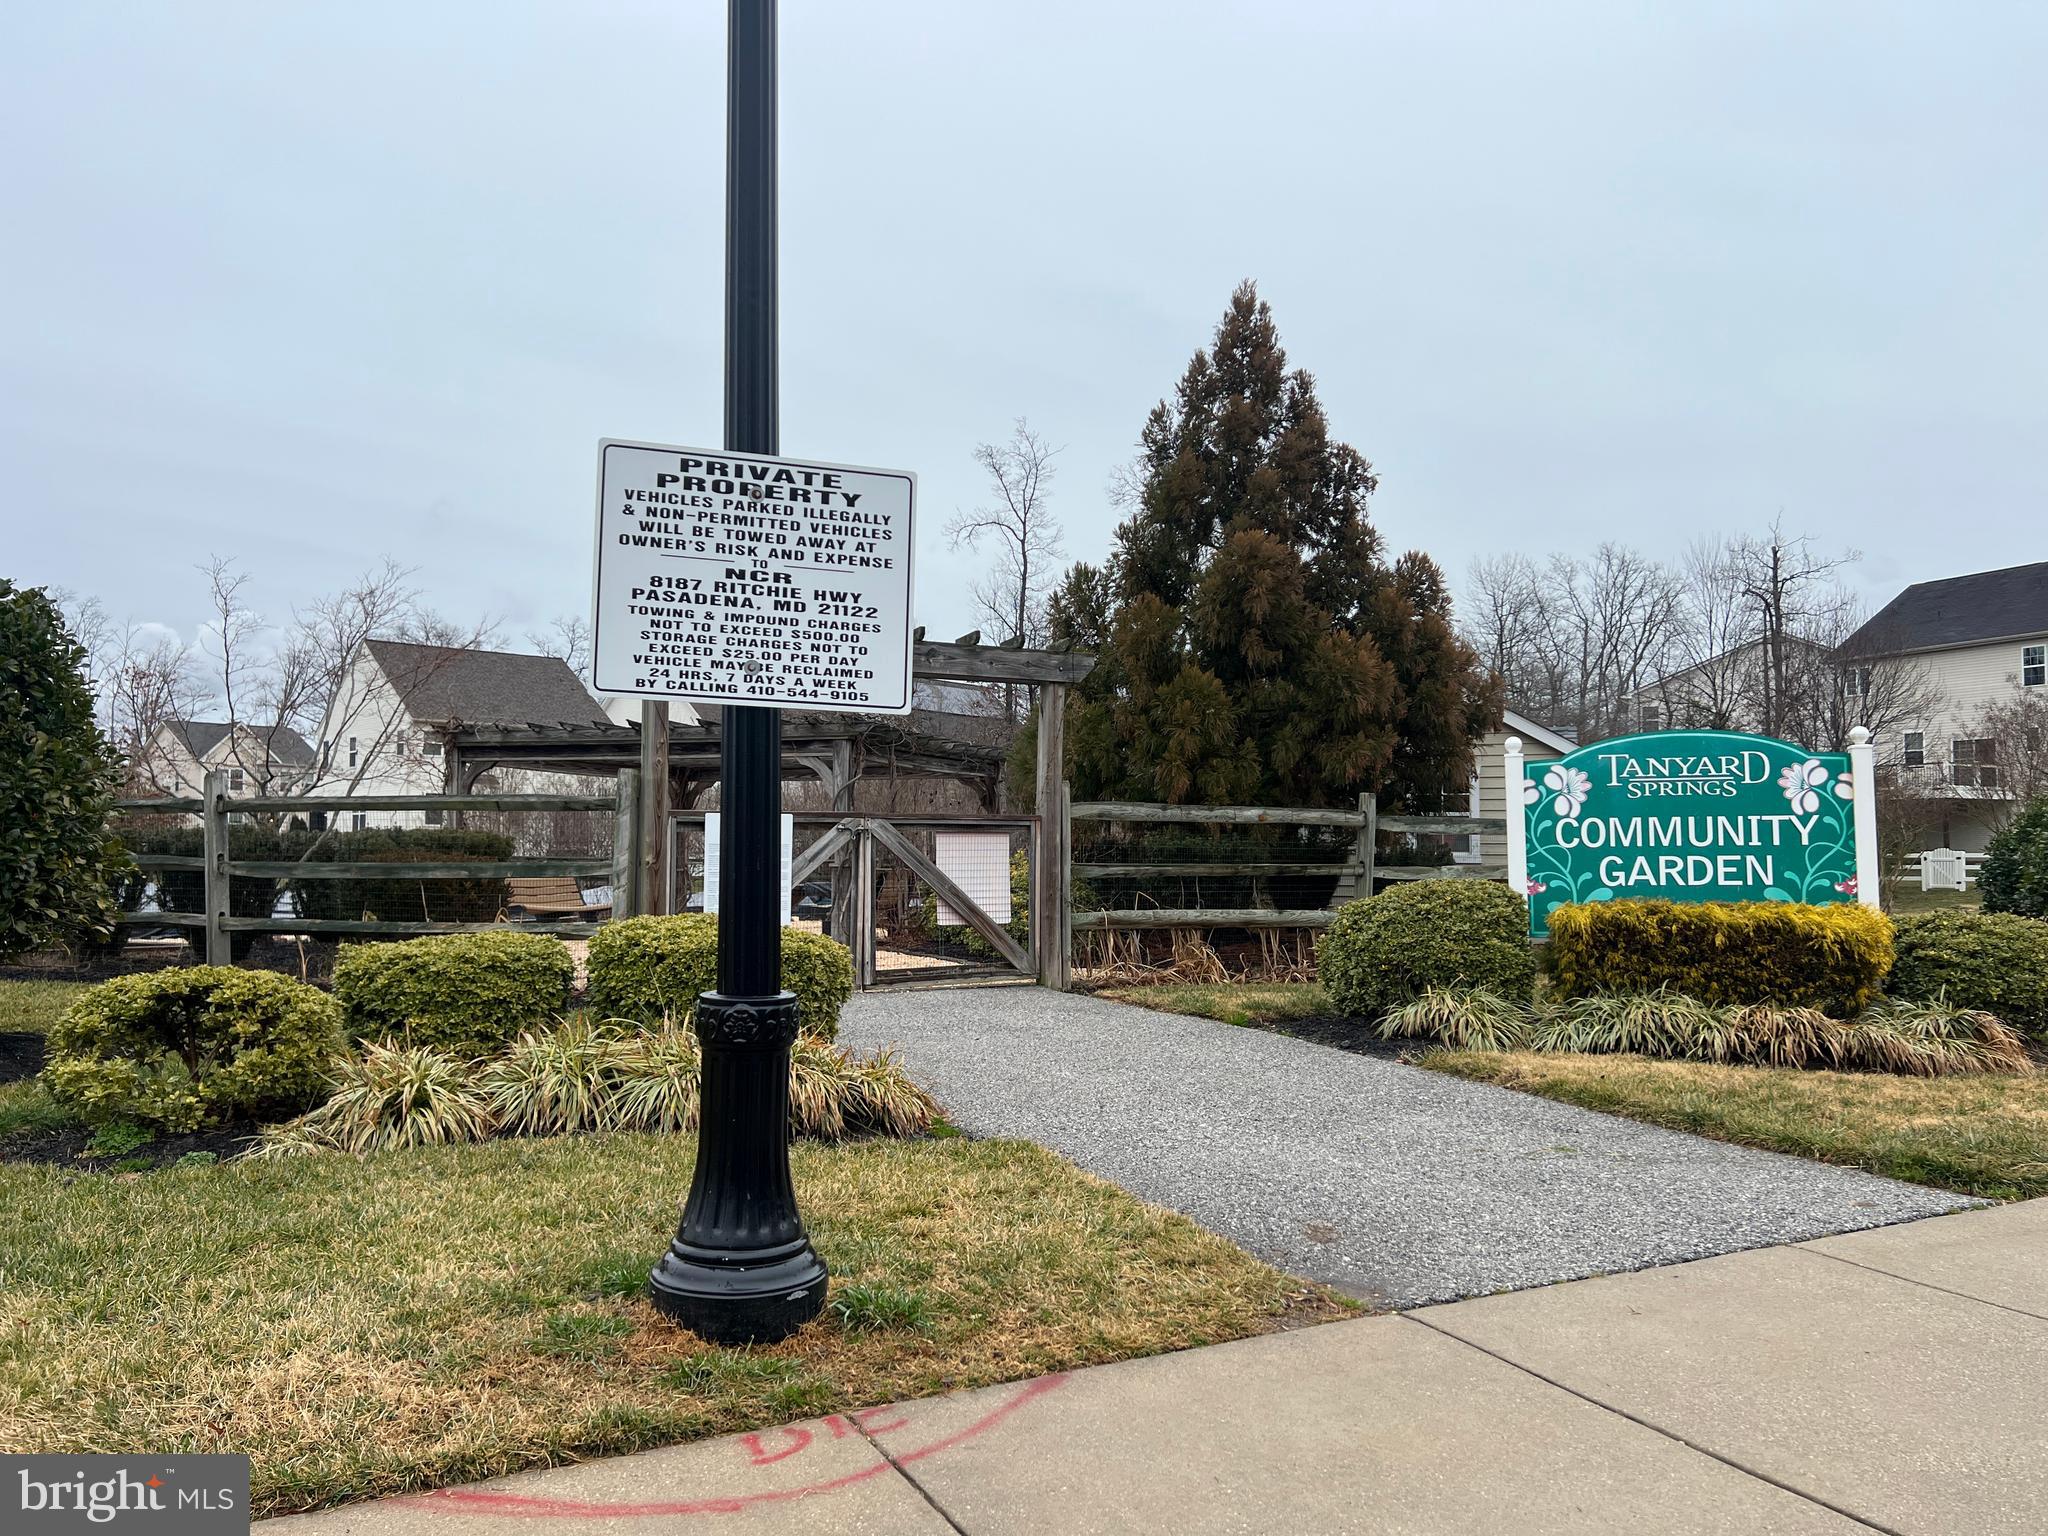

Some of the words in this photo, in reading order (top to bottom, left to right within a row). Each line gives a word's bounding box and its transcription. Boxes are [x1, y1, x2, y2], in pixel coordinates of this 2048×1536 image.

[680, 458, 842, 489] PRIVATE
[657, 473, 862, 507] PROPERTY
[624, 488, 713, 508] VEHICLES
[723, 499, 794, 516] PARKED
[803, 507, 892, 526] ILLEGALLY
[622, 504, 635, 515] &
[646, 506, 800, 532] NON-PERMITTED
[810, 522, 892, 540] VEHICLES
[639, 520, 683, 535] WILL
[692, 525, 714, 538] BE
[723, 528, 786, 545] TOWED
[796, 536, 846, 550] AWAY
[855, 542, 877, 553] AT
[619, 534, 706, 552] OWNER'S
[715, 543, 758, 557] RISK
[768, 548, 804, 561] AND
[814, 552, 893, 569] EXPENSE
[751, 559, 768, 569] TO
[650, 576, 702, 590] 8187
[714, 581, 802, 599] RITCHIE
[814, 590, 862, 604] HWY
[725, 568, 792, 584] NCR
[632, 588, 761, 611] PASADENA,
[774, 600, 806, 612] MD
[818, 603, 878, 619] 21122
[627, 604, 695, 619] TOWING
[704, 611, 715, 620] &
[725, 613, 799, 626] IMPOUND
[808, 619, 881, 633] CHARGES
[650, 619, 683, 630] NOT
[691, 622, 711, 632] TO
[720, 624, 782, 637] EXCEED
[640, 630, 717, 644] STORAGE
[726, 637, 802, 650] CHARGES
[810, 643, 841, 653] NOT
[849, 646, 868, 655] TO
[649, 643, 713, 656] EXCEED
[791, 653, 820, 664] PER
[829, 656, 858, 666] DAY
[633, 654, 702, 668] VEHICLE
[710, 660, 745, 670] MAY
[782, 665, 873, 679] RECLAIMED
[649, 668, 670, 678] 24
[679, 670, 718, 682] HRS,
[726, 673, 735, 682] 7
[743, 674, 785, 685] DAYS
[794, 678, 804, 686] A
[813, 679, 857, 690] WEEK
[636, 679, 657, 688] BY
[666, 680, 738, 693] CALLING
[747, 686, 869, 701] 410-544-9105
[1599, 751, 1770, 786] TANYARD
[1627, 781, 1737, 798] SPRINGS
[1555, 815, 1819, 848] COMMUNITY
[1600, 855, 1774, 886] GARDEN
